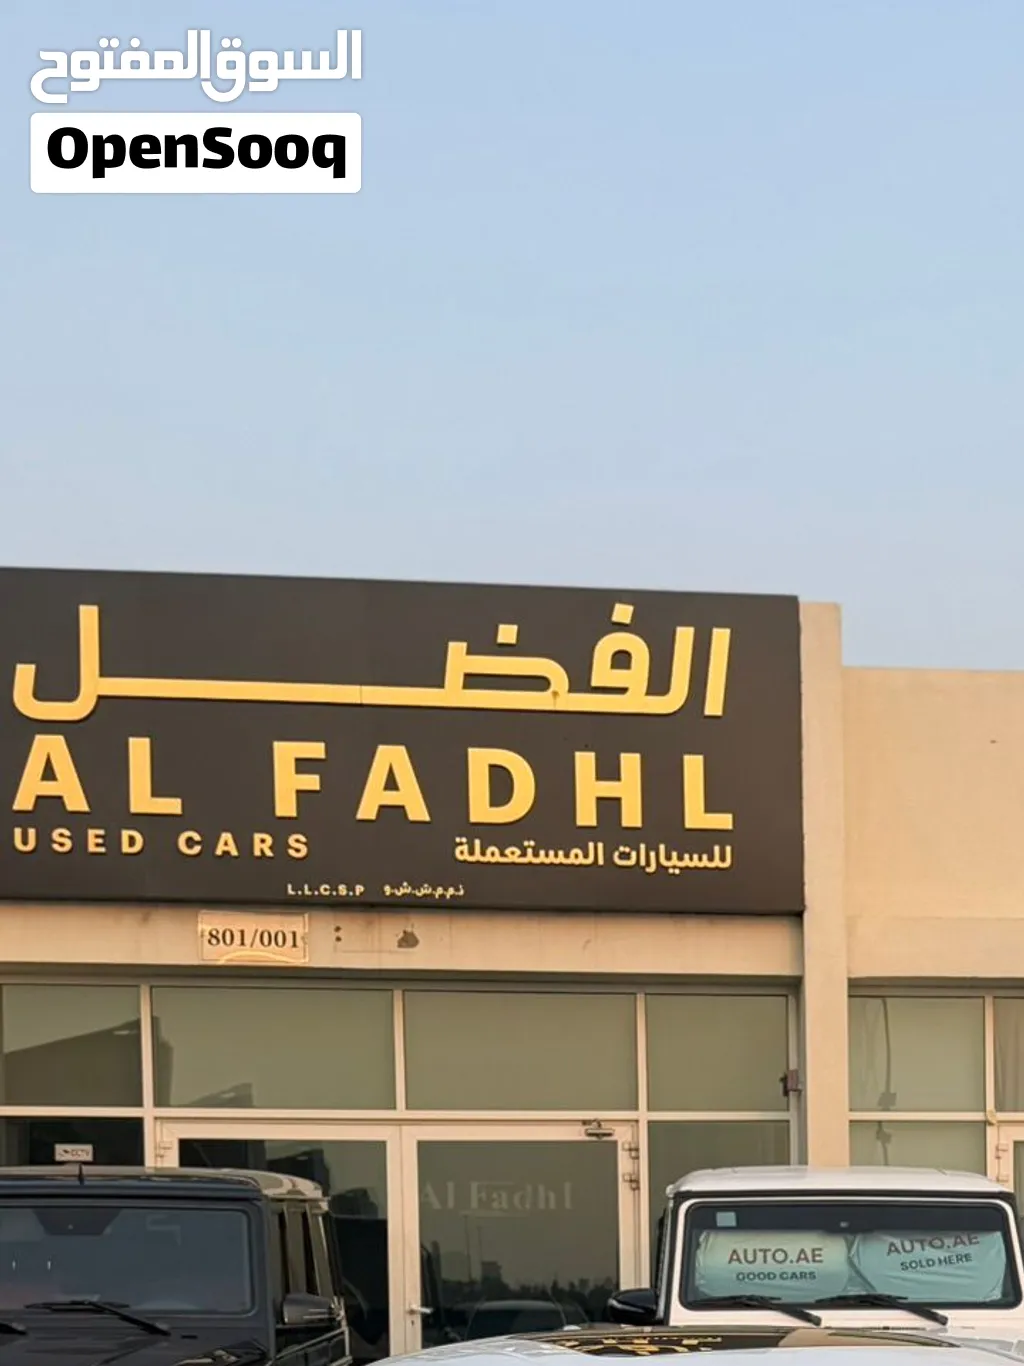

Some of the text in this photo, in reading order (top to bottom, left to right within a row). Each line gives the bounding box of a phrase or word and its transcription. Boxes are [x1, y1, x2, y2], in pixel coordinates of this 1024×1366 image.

[12, 602, 732, 721] الفضل
[12, 734, 733, 830] AL FADHL
[12, 828, 311, 860] USED CARS
[454, 836, 733, 875] للسيارات المستعملة
[287, 883, 366, 896] L.L.C.S.P
[207, 928, 300, 949] 801/001
[886, 1231, 980, 1257] AUTO.AE
[728, 1248, 824, 1265] AUTO.AE
[900, 1253, 973, 1272] SOLD HERE
[735, 1270, 817, 1282] GOOD CARS
